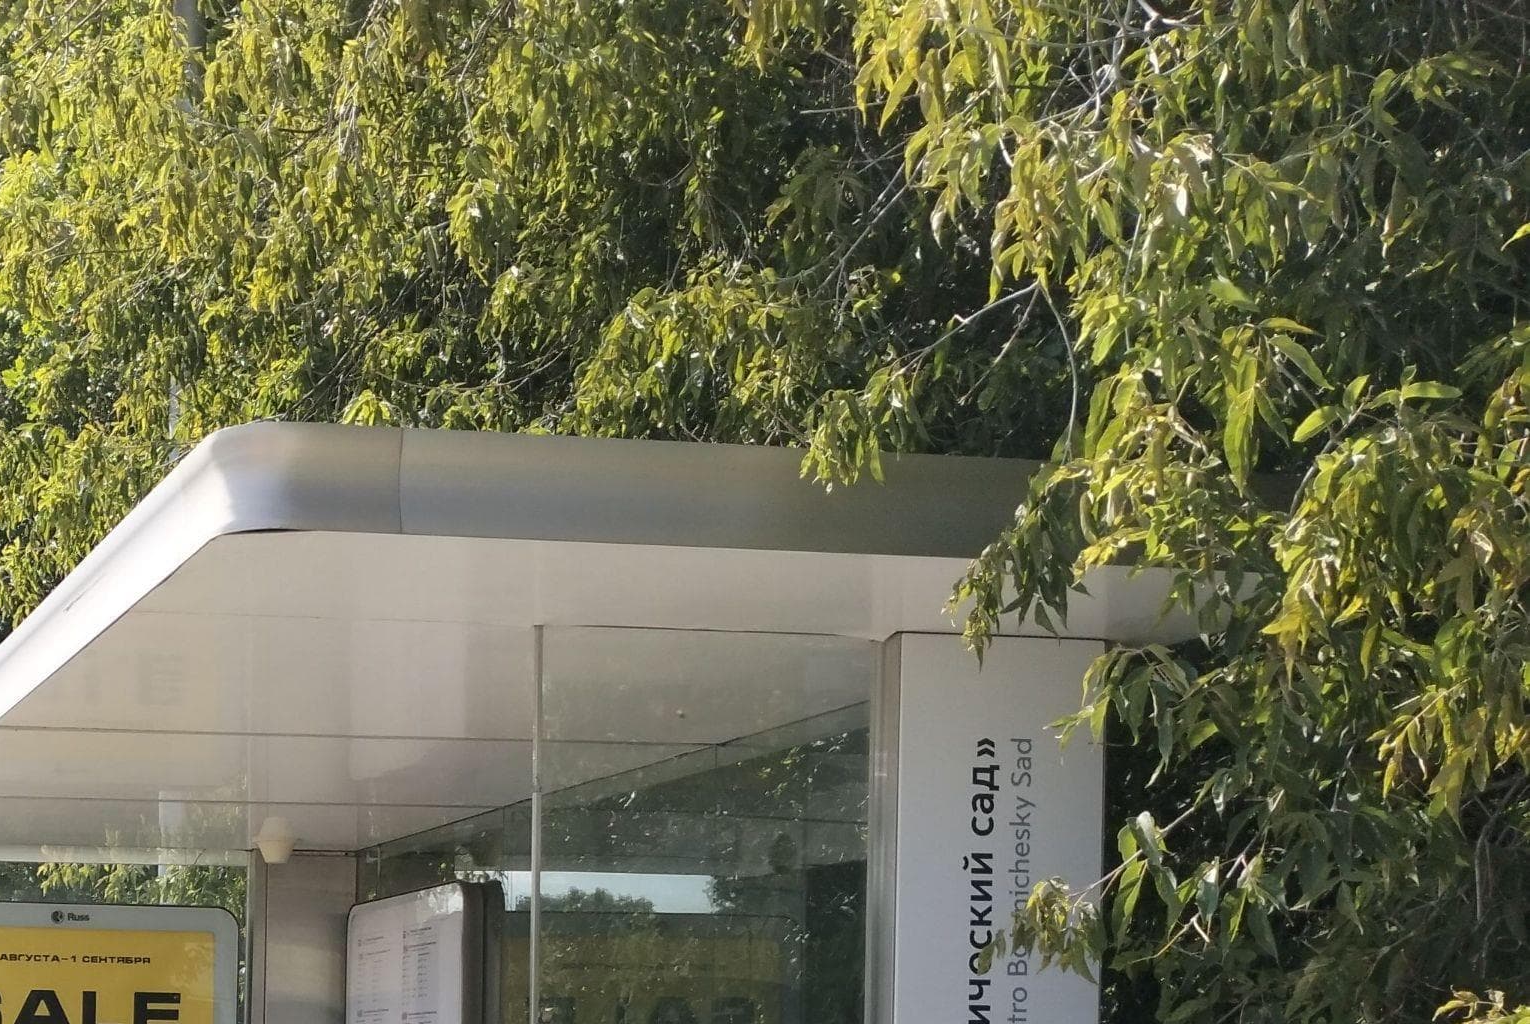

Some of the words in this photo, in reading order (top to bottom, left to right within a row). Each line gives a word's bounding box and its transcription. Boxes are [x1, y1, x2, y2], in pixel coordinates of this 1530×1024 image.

[971, 737, 1000, 836] сад»
[1011, 738, 1033, 787] Sad
[1007, 796, 1036, 976] Bonichesky
[67, 912, 90, 922] Russ
[82, 955, 151, 965] СЕНТЯБРЯ
